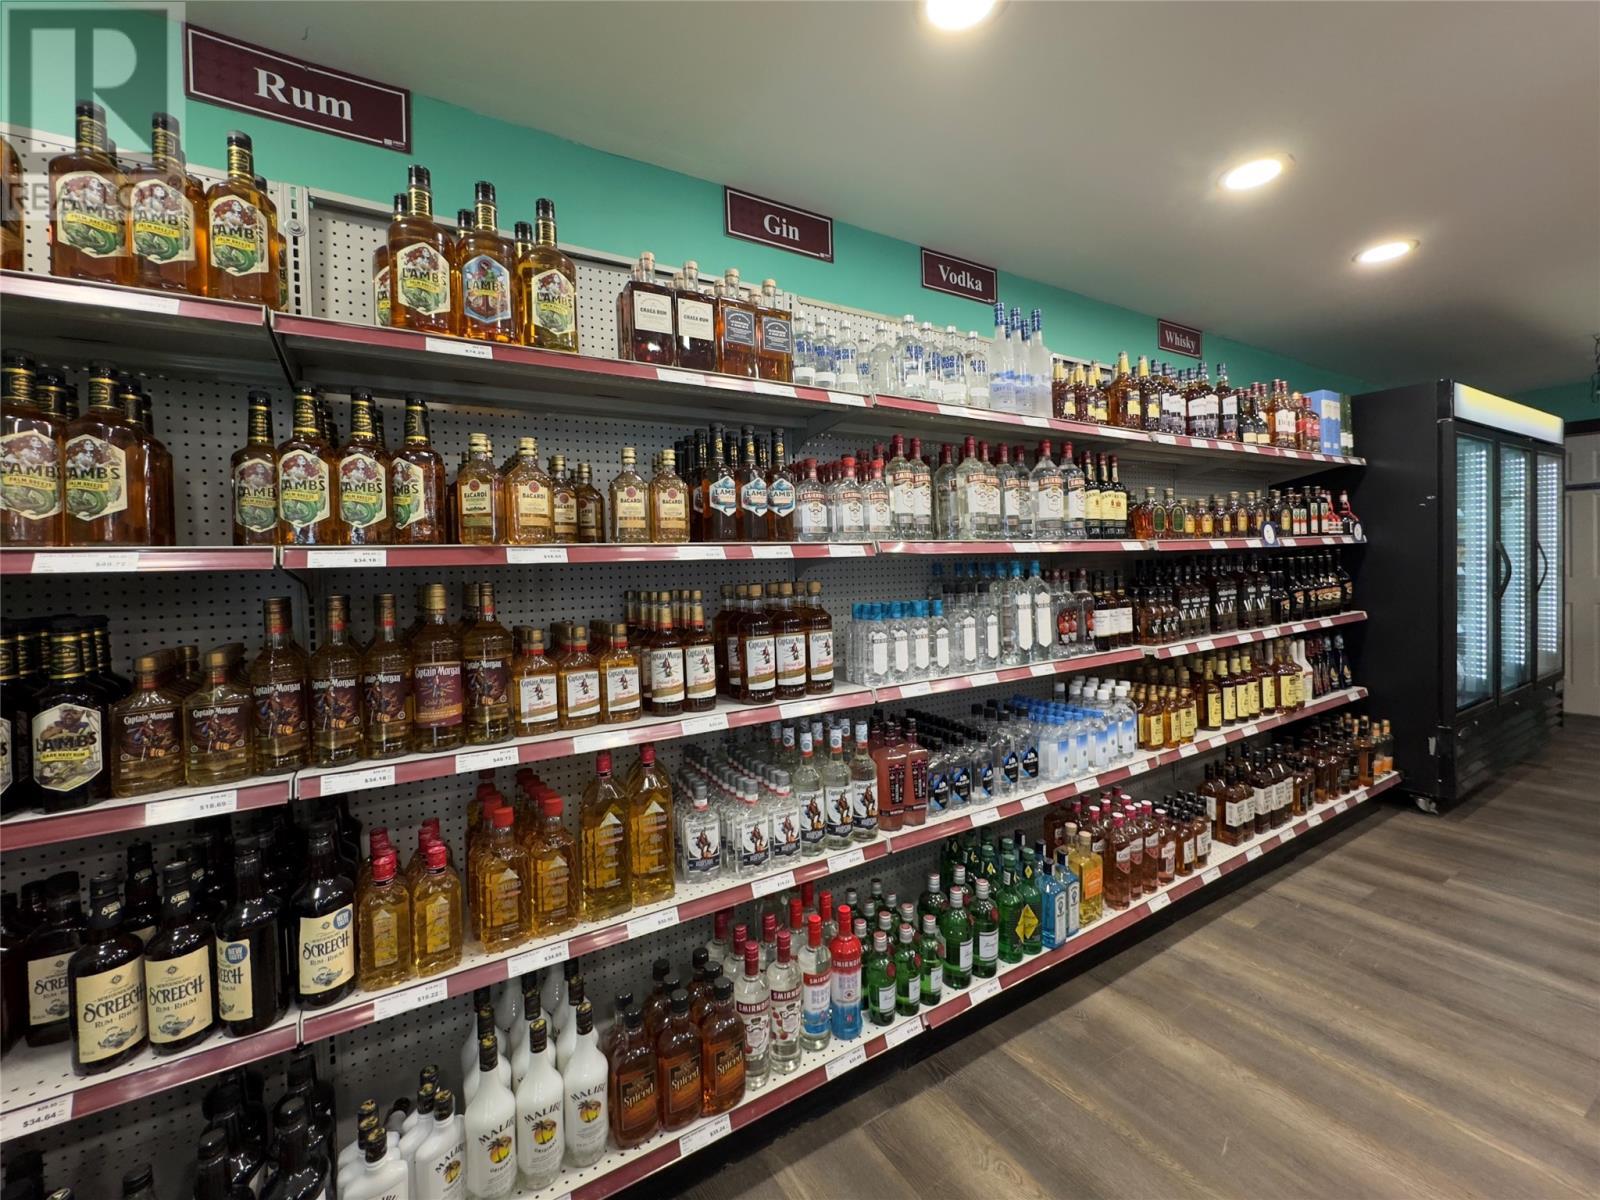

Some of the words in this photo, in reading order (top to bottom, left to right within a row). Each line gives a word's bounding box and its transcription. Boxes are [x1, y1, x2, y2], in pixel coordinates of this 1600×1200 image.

[254, 67, 353, 121] Rum
[763, 214, 800, 241] Gin
[938, 264, 983, 292] Vodka
[1165, 330, 1195, 353] Whisky
[331, 677, 355, 688] Morgan
[377, 673, 400, 683] Morgan
[415, 666, 437, 679] Captain
[124, 714, 149, 726] Captain
[149, 711, 174, 721] Morgan
[193, 707, 215, 719] Captain
[215, 706, 239, 715] Morgan
[336, 910, 349, 921] NEW
[227, 946, 243, 956] NEW
[303, 930, 350, 961] SCREECH
[220, 966, 244, 984] EECH
[149, 974, 205, 1005] SCREECH
[84, 981, 147, 1023] SCREECH
[717, 1052, 743, 1075] Spiced
[671, 1066, 700, 1090] Spiced
[624, 1083, 655, 1108] Spiced
[23, 1111, 57, 1129] $34.64
